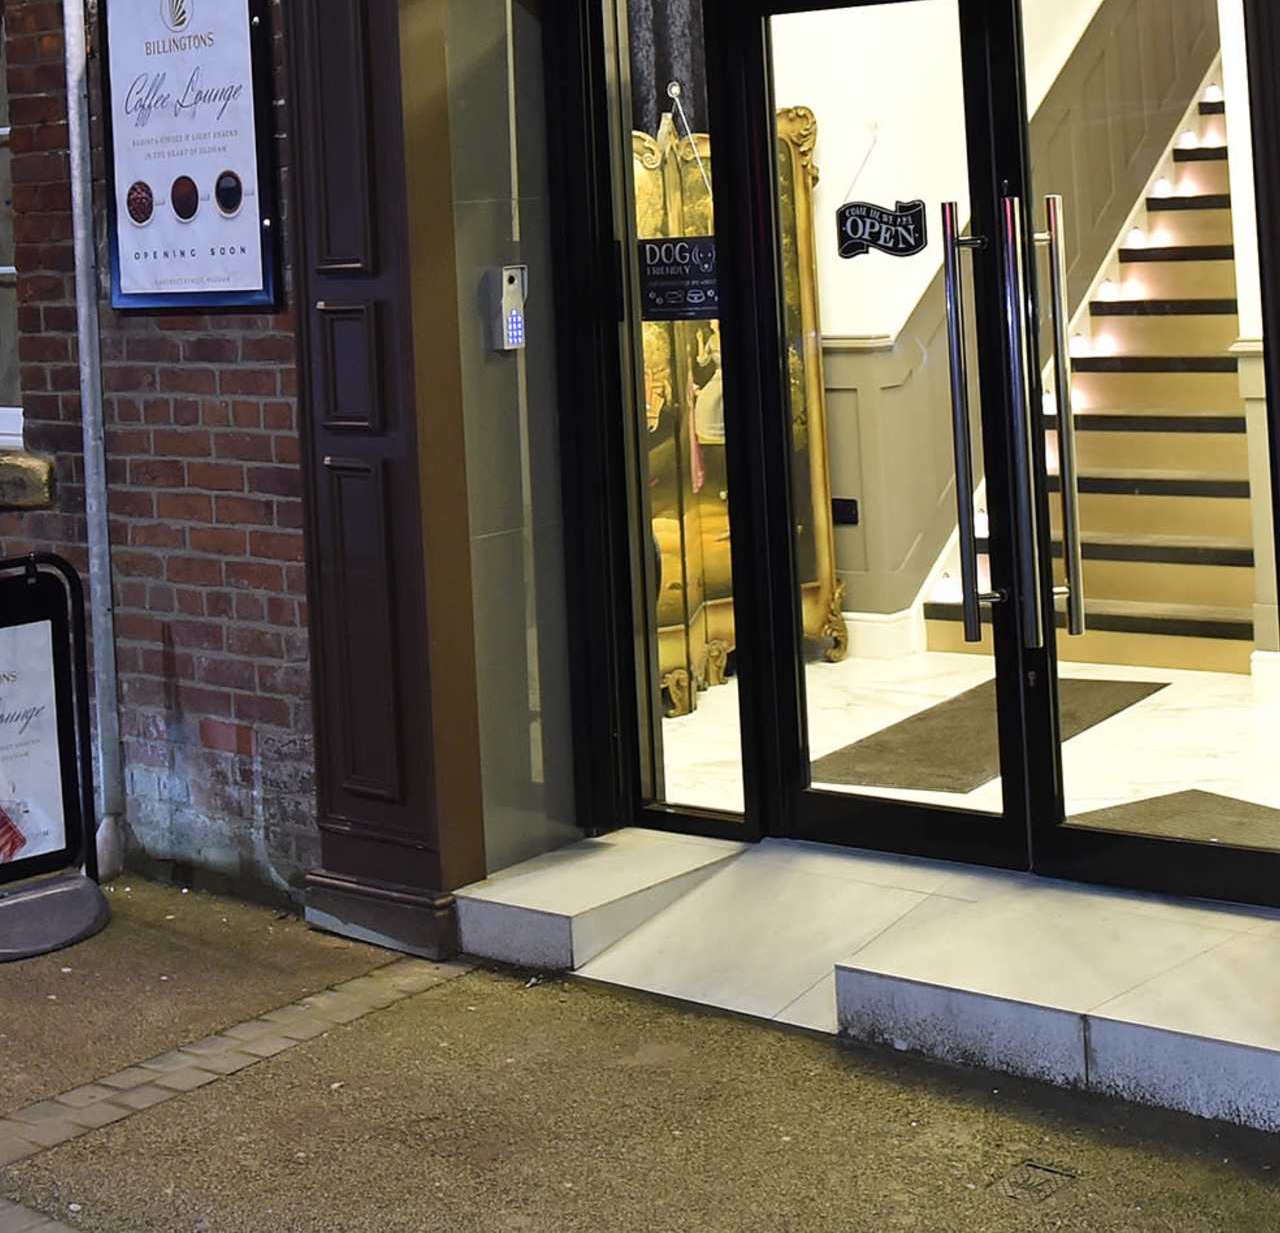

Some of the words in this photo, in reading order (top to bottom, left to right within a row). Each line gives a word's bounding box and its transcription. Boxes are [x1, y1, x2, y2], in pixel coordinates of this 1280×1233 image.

[145, 32, 215, 56] BILLINGTONS
[125, 71, 172, 128] Coffee
[174, 66, 243, 120] Lounge
[846, 216, 915, 248] OPEN
[134, 248, 196, 260] OPENING
[210, 246, 246, 256] SOON
[645, 242, 690, 265] DOG
